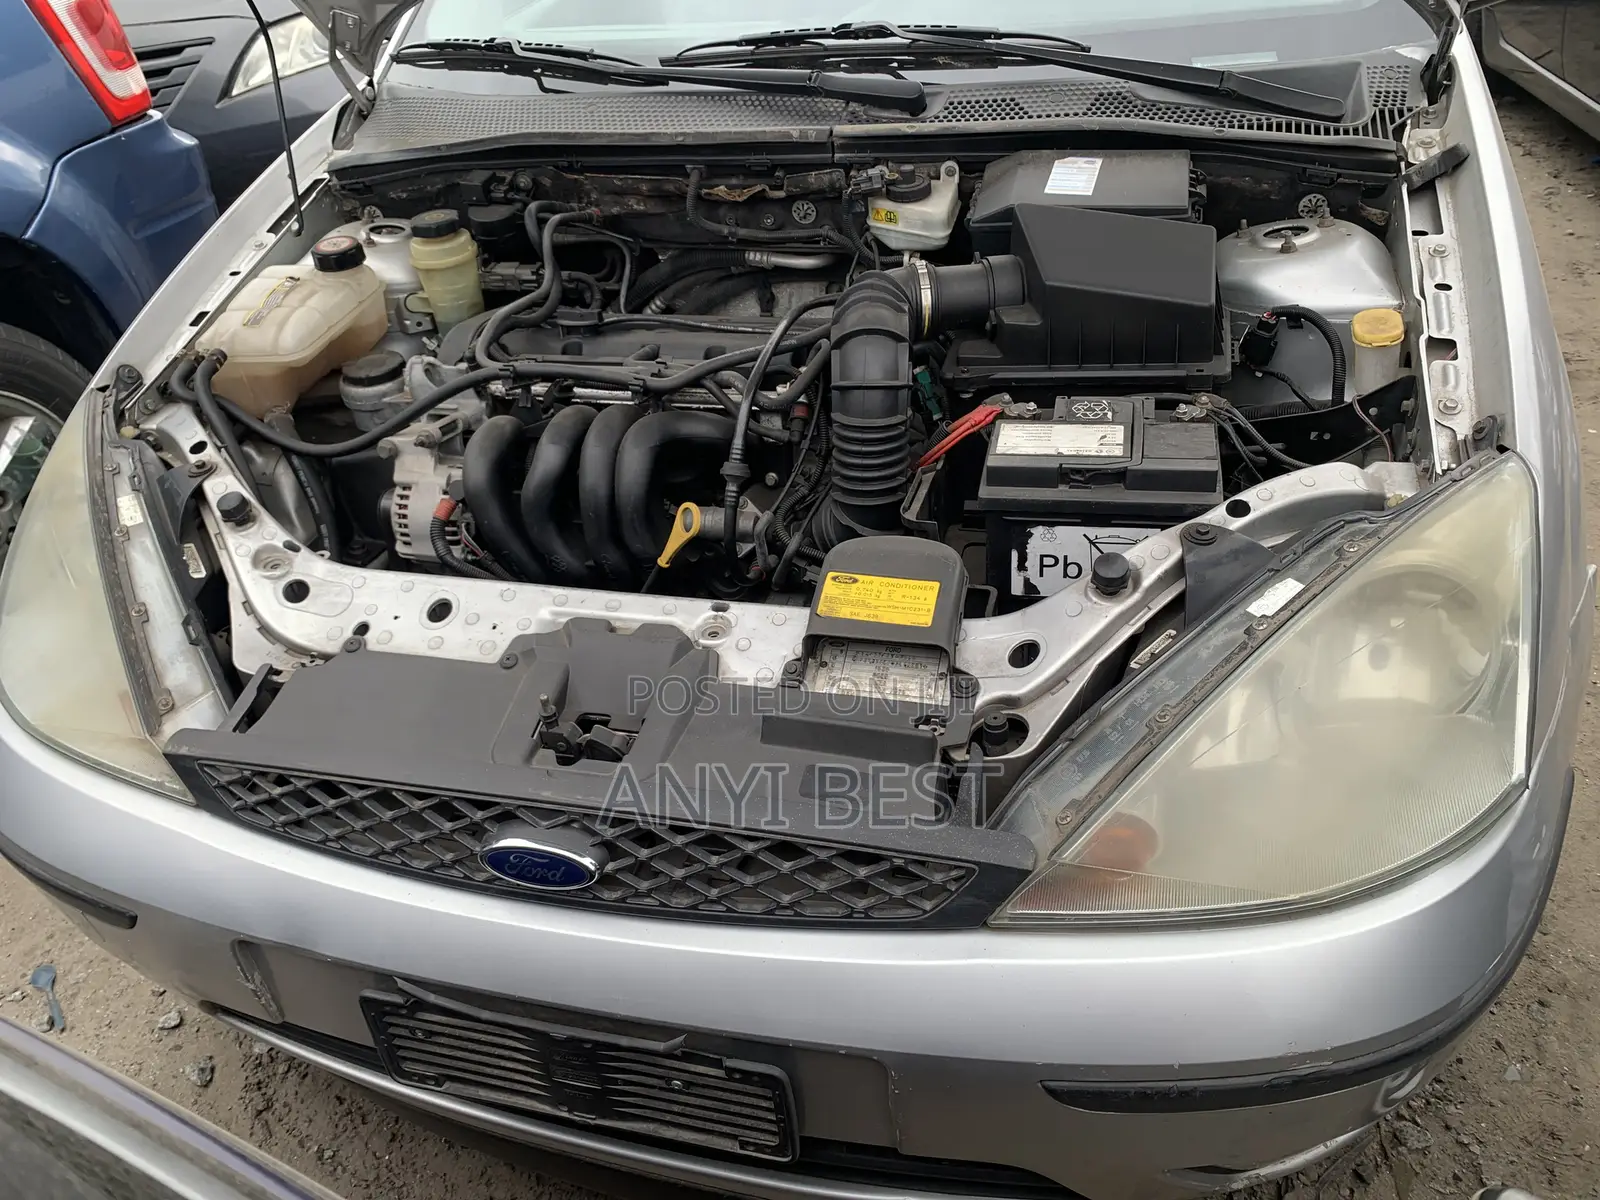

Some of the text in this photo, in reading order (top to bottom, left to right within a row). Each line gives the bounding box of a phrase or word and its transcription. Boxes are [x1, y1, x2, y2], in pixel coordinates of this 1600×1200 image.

[1039, 554, 1083, 580] Pb
[879, 581, 935, 591] CONDITIONER
[885, 646, 902, 654] FORD
[504, 852, 566, 883] Ford
